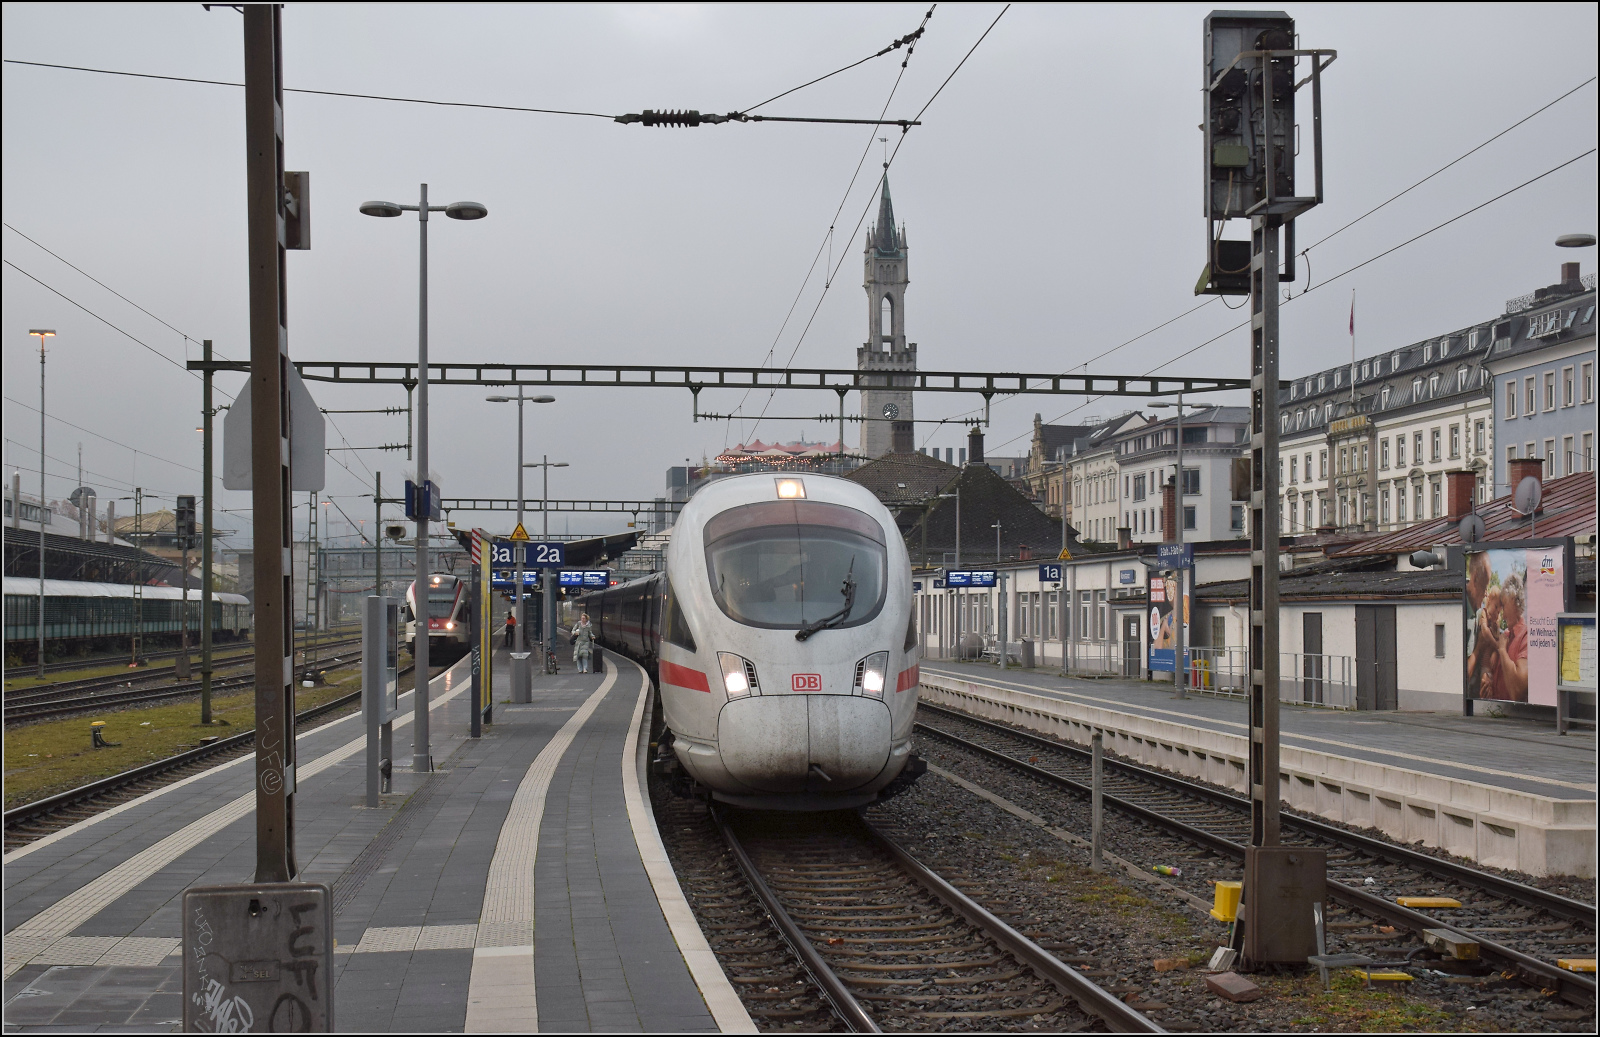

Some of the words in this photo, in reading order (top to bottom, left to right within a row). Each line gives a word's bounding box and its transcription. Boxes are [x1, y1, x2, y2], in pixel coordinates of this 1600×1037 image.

[492, 544, 511, 563] 3a
[536, 544, 561, 563] 2a
[1541, 554, 1553, 567] dm
[1043, 565, 1059, 579] 1a
[1529, 616, 1546, 626] Besucht
[1530, 627, 1536, 636] An
[1529, 638, 1538, 647] und
[1538, 638, 1550, 649] jeden
[795, 676, 819, 689] DB
[253, 970, 271, 978] SEL
